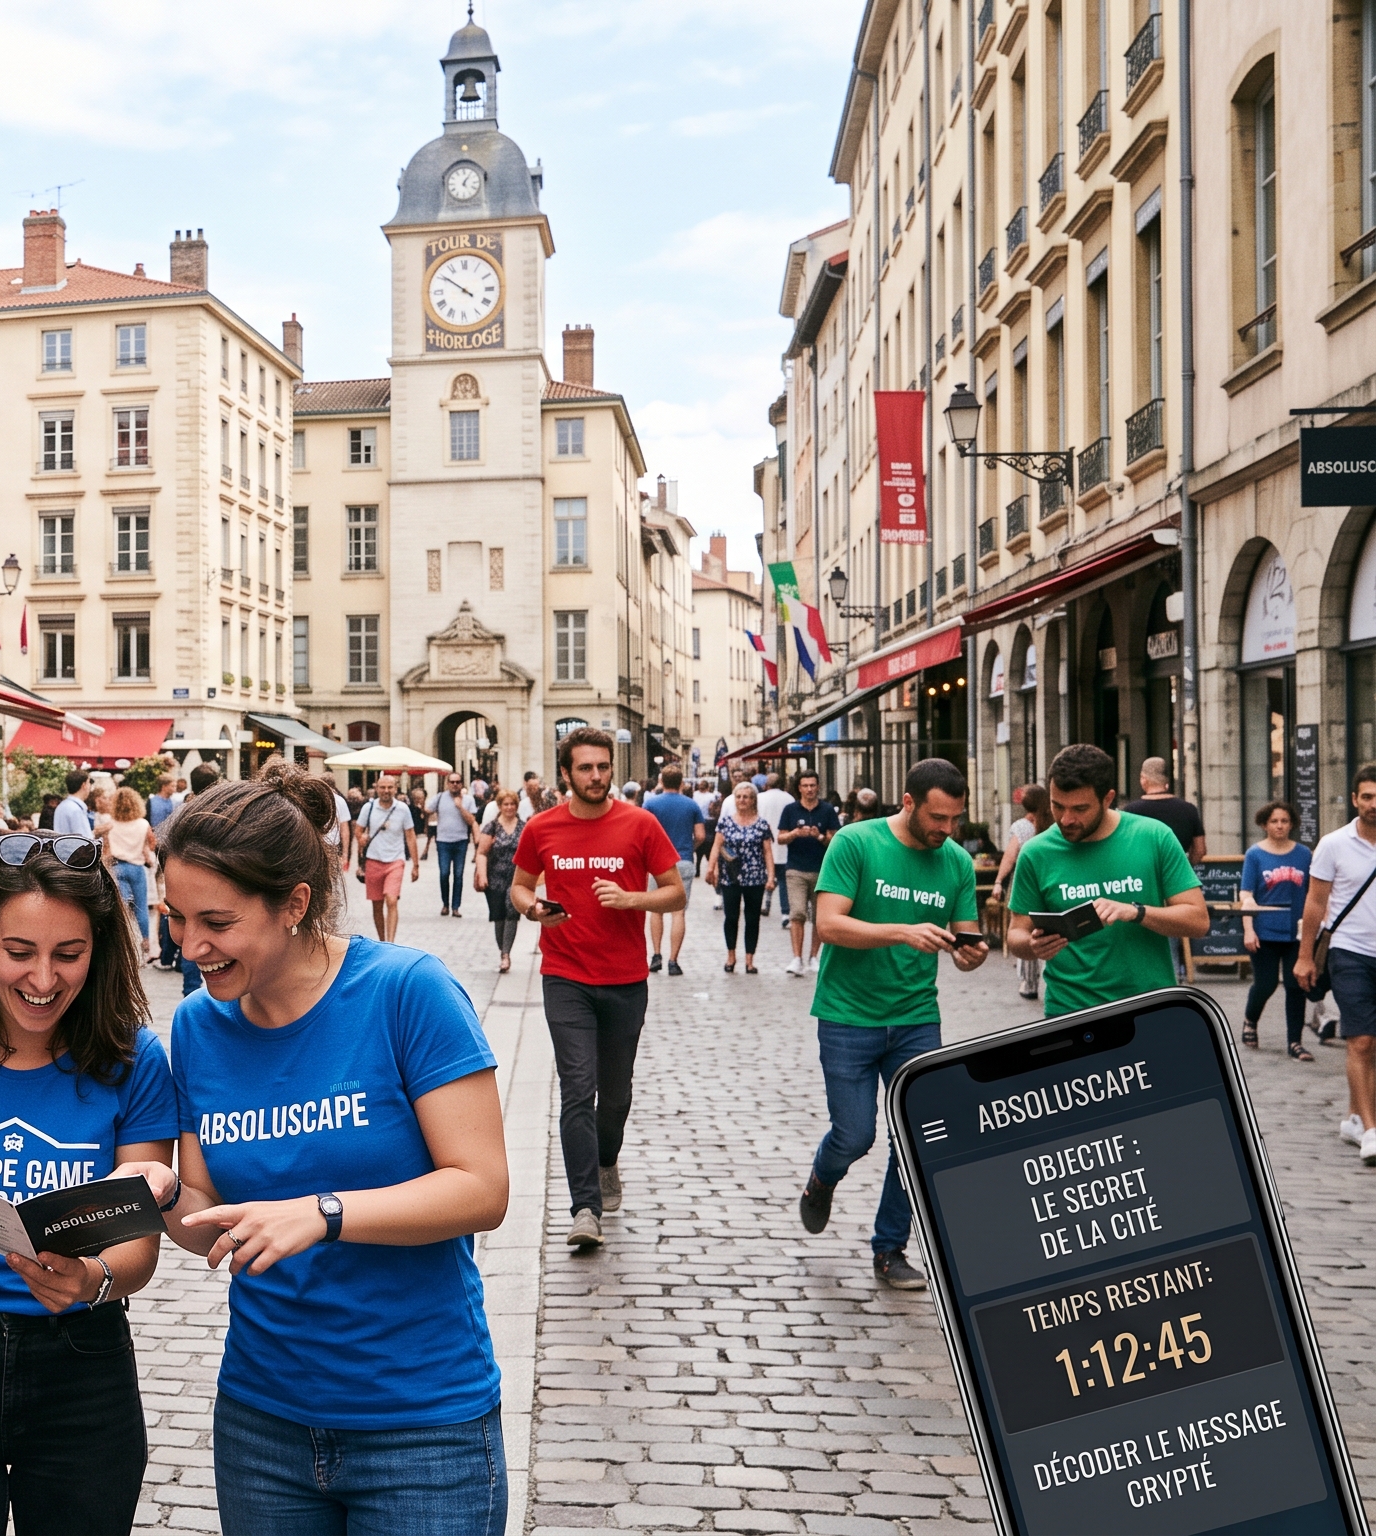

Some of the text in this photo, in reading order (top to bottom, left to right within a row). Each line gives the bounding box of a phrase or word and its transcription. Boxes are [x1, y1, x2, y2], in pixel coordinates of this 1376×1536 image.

[428, 234, 471, 256] TOUR
[552, 855, 624, 872] Team rouge
[1059, 875, 1143, 900] Team verte
[875, 879, 947, 910] Team verte
[199, 1092, 369, 1146] ABSOLUSCAPE
[977, 1060, 1153, 1134] ABSOLUSCAPE
[1023, 1134, 1126, 1187] OBJECTIF
[44, 1202, 142, 1237] ABSOLUSCAPE
[1030, 1167, 1150, 1223] LE SECRET
[1039, 1197, 1163, 1260] DE LA CITÉ
[1023, 1260, 1214, 1333] TEMPS RESTANT:
[1055, 1311, 1213, 1398] 1:12:45
[1032, 1399, 1288, 1492] DÉCODER LE MESSAGE
[1126, 1455, 1218, 1510] CRYPTÉ
